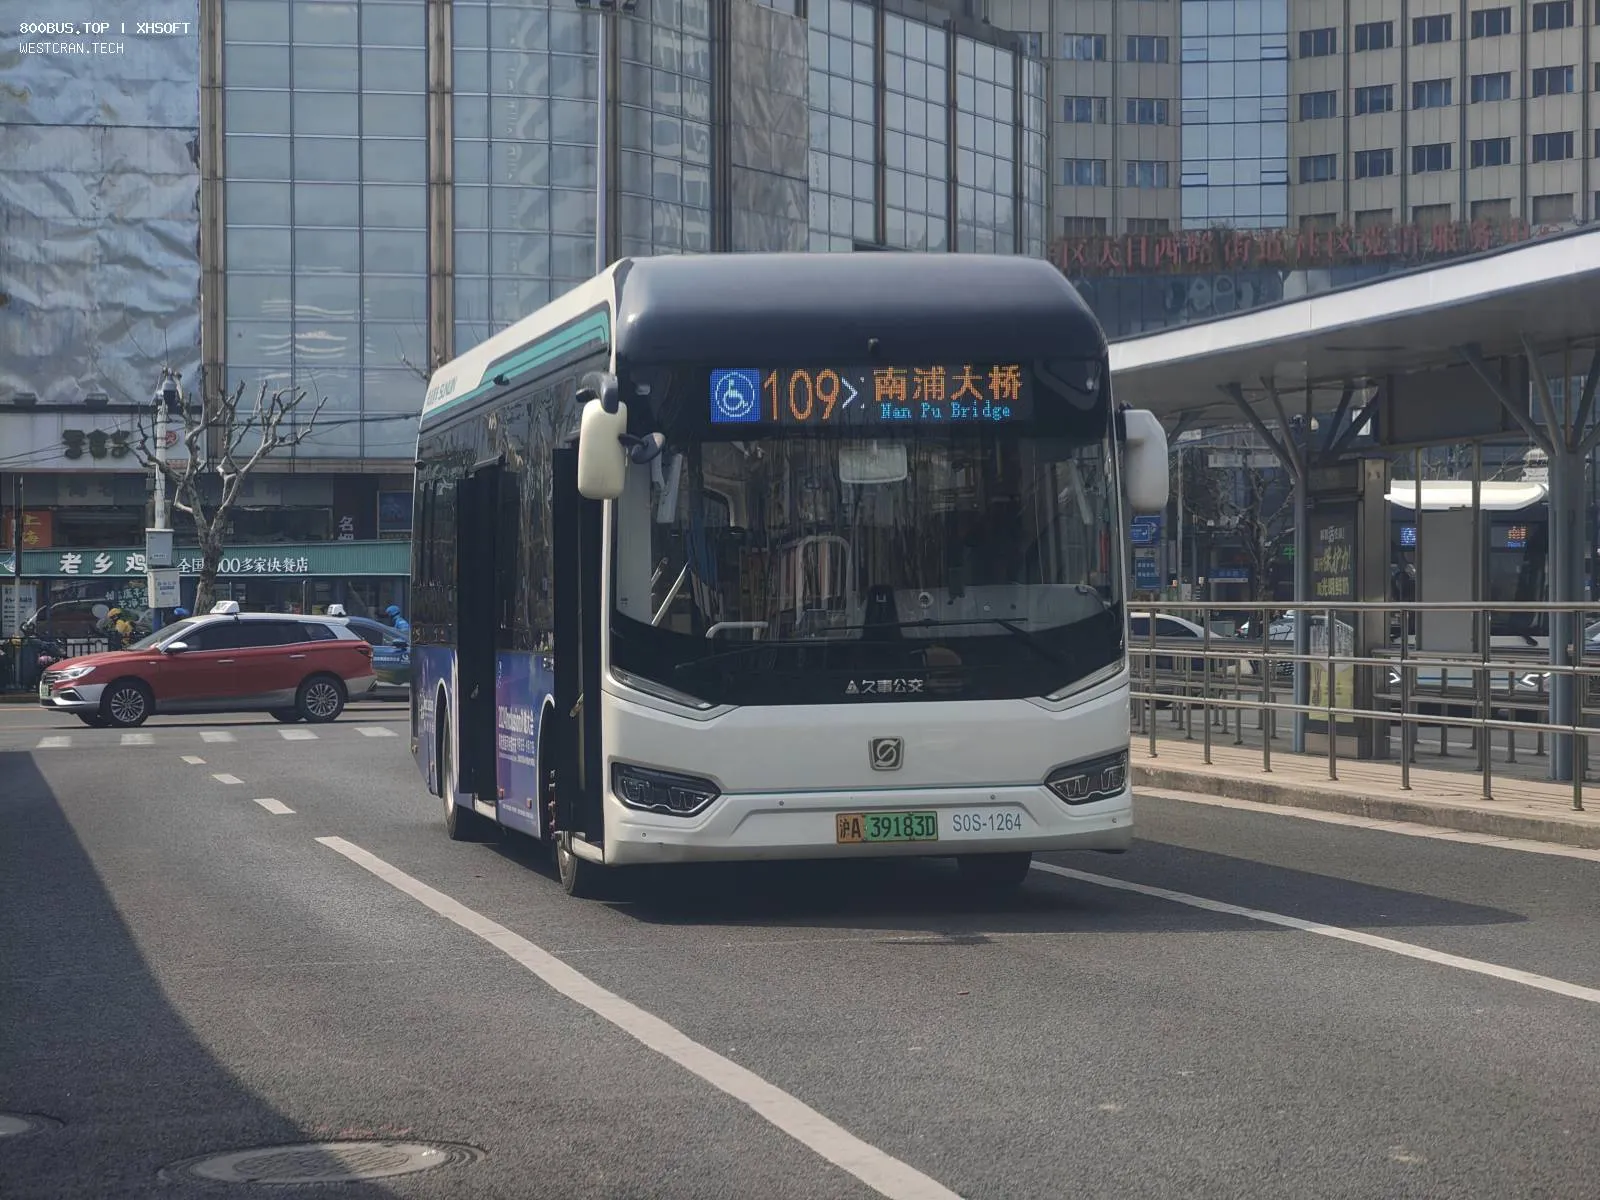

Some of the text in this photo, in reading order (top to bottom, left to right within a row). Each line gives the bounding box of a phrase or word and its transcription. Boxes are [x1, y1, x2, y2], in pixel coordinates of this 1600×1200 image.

[873, 364, 1022, 401] 南浦大桥
[764, 369, 840, 421] 109
[880, 402, 1011, 420] Nan Pu Bridge
[60, 552, 147, 574] 老乡鸡
[177, 557, 308, 573] 全国00多家快餐店
[861, 678, 924, 694] 久事公交
